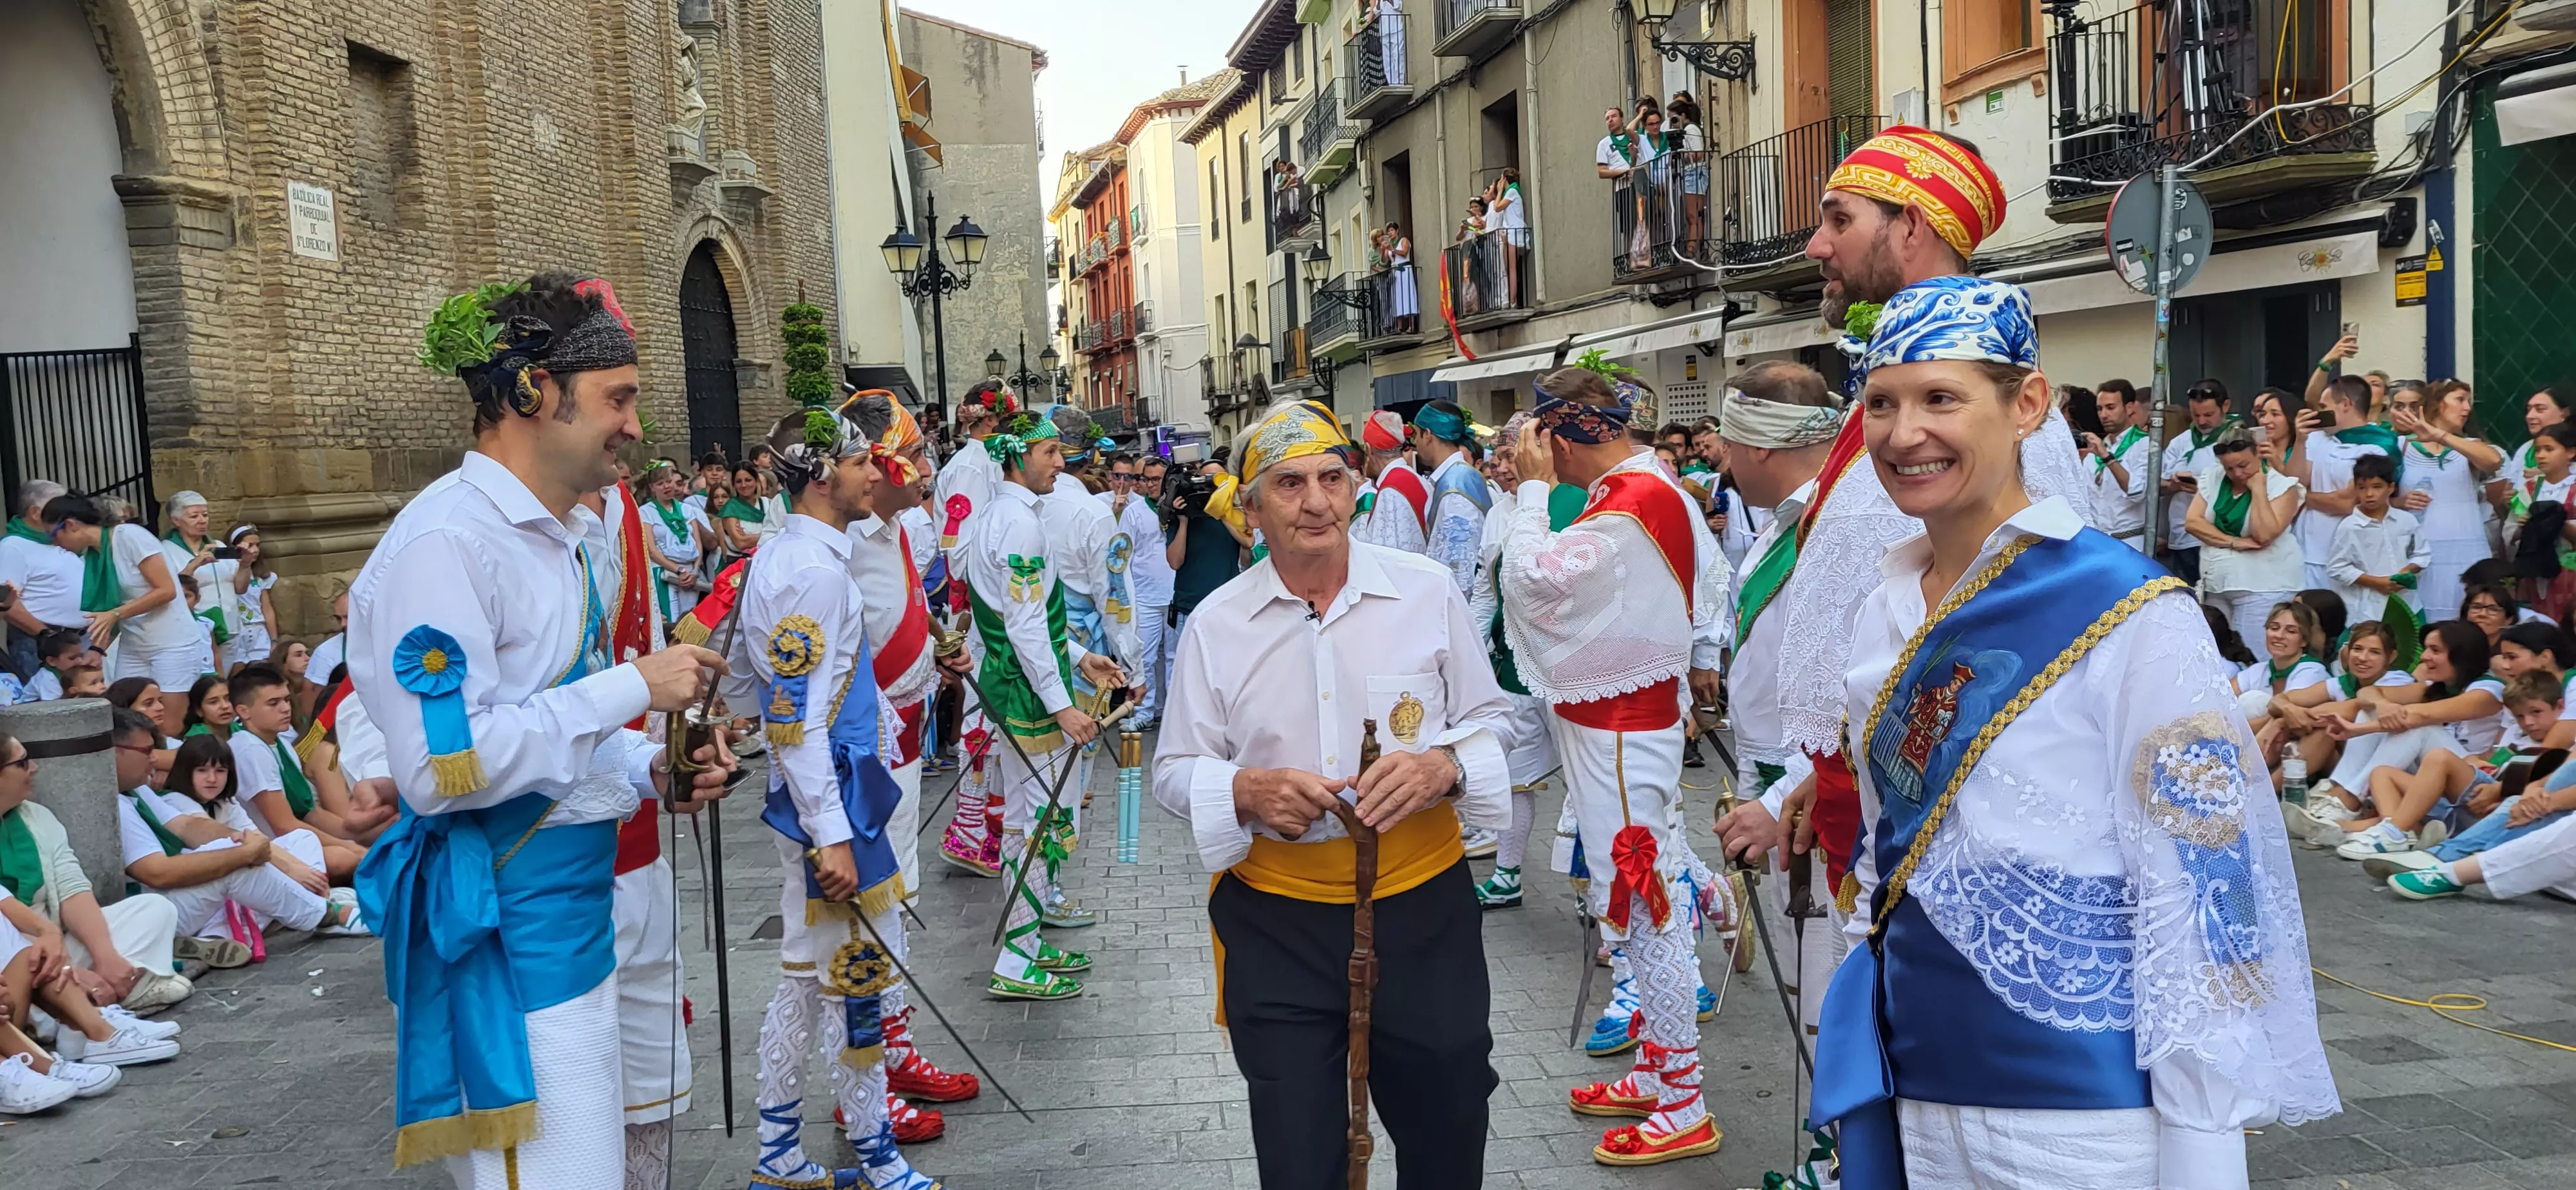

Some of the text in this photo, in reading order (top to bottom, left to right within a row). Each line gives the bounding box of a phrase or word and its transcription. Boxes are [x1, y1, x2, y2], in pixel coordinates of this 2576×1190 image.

[293, 188, 329, 207] BASÍLICA REAL
[294, 204, 330, 222] Y PARROQUIAL
[310, 223, 317, 234] DE
[303, 236, 326, 252] LORENZO
